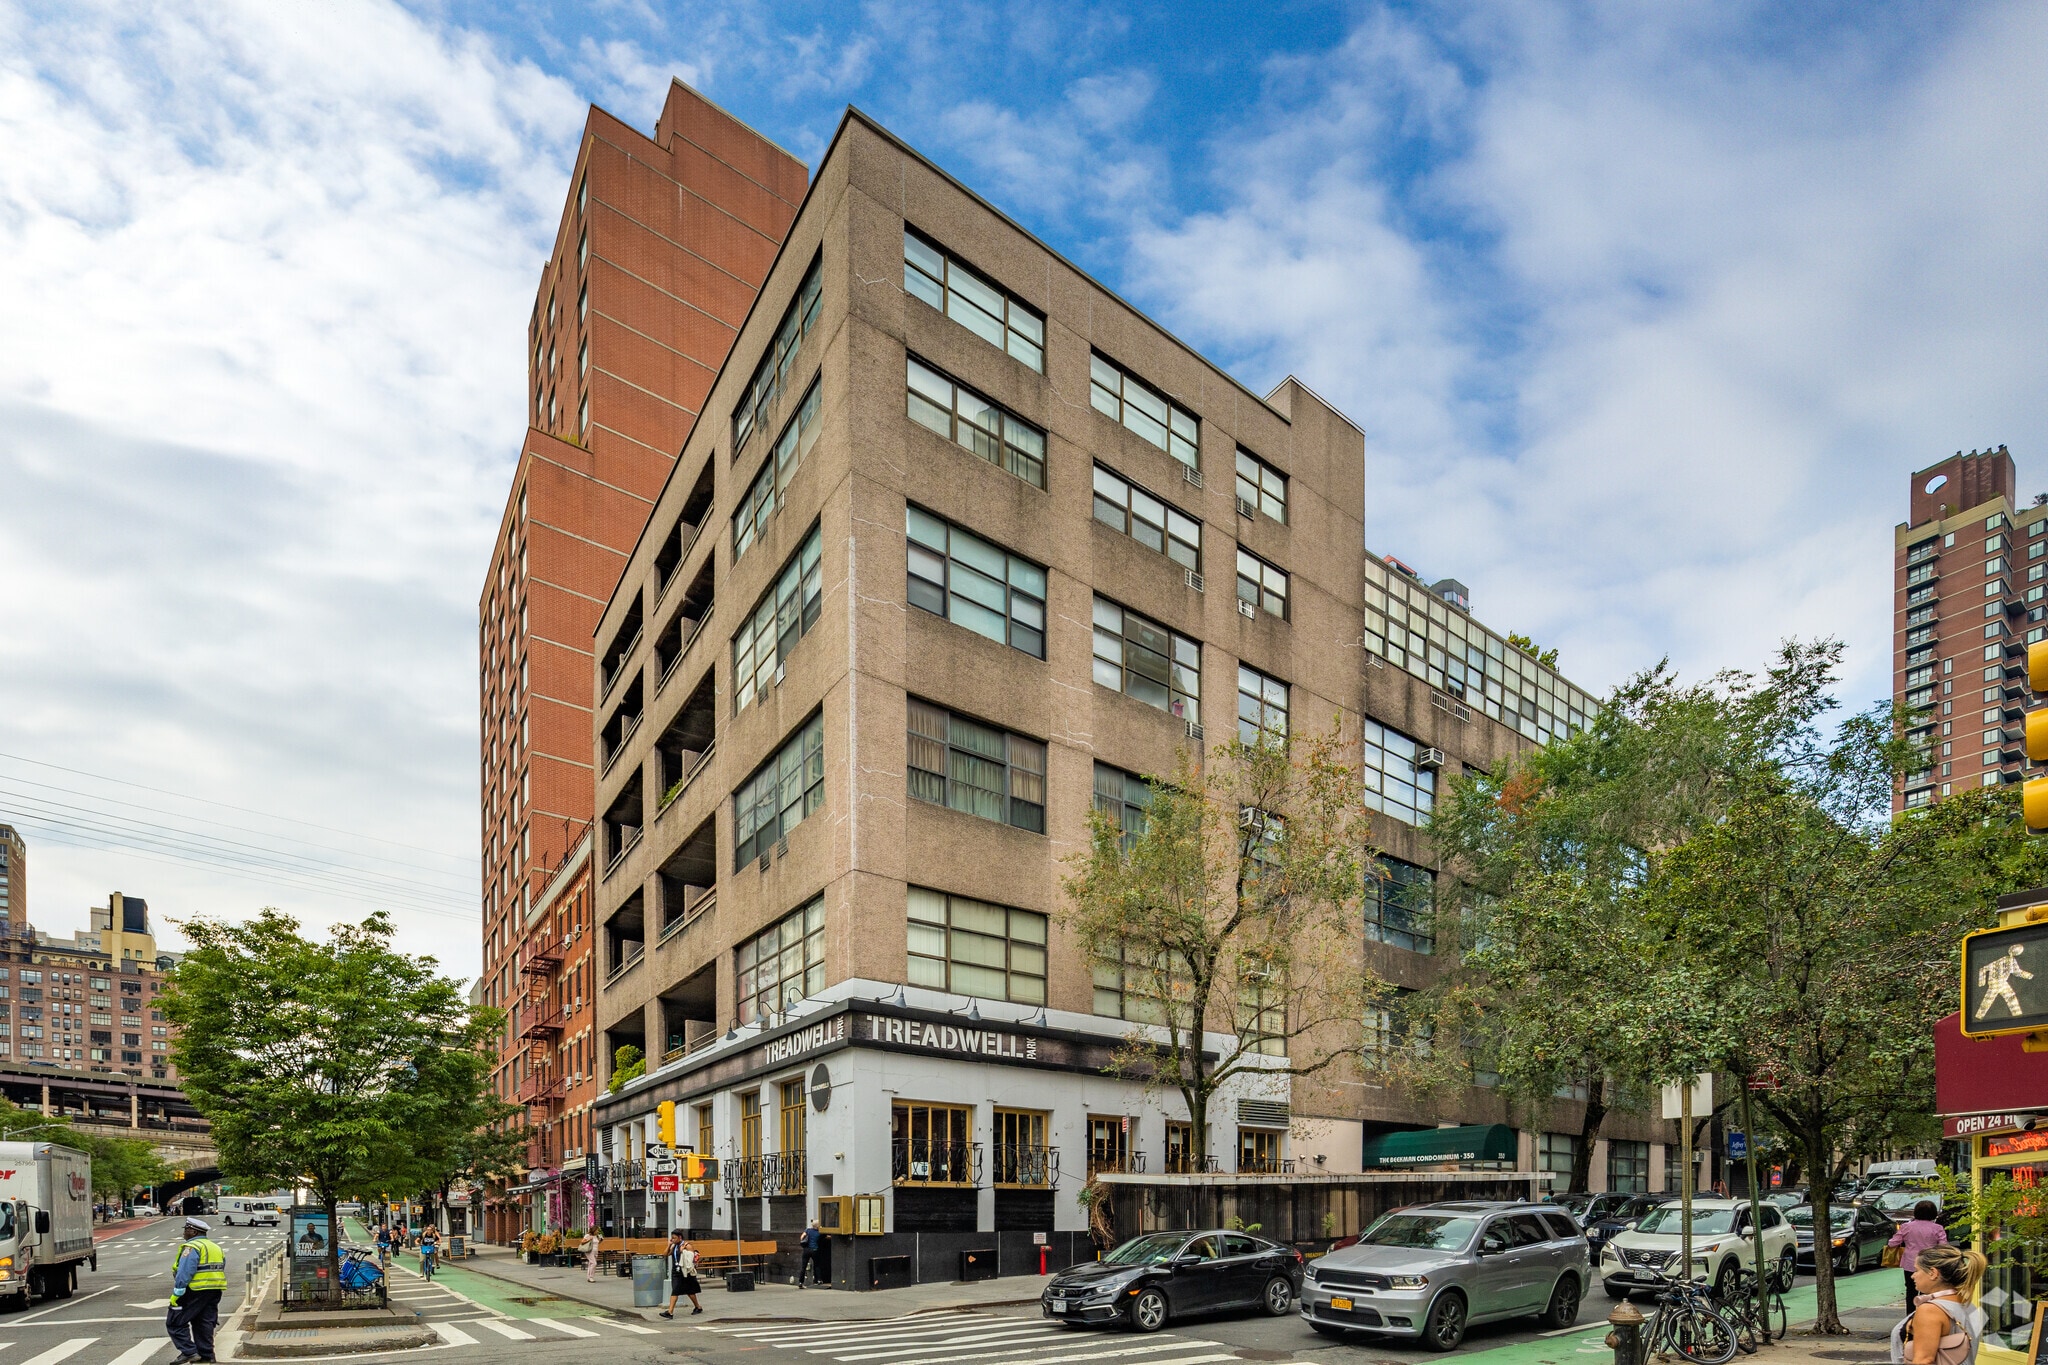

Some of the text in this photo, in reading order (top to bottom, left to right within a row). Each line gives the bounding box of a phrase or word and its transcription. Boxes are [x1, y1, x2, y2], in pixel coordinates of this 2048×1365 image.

[836, 1015, 844, 1041] PARK
[866, 1014, 1024, 1059] TREADWELL
[764, 1020, 836, 1065] TREADWELL
[1026, 1037, 1037, 1060] PARK
[1956, 1116, 1985, 1134] OPEN
[1987, 1115, 2001, 1128] 24
[1389, 1155, 1416, 1163] BEEKMAN
[1416, 1153, 1460, 1162] CONDOMINIUM
[296, 1242, 314, 1250] STAY
[296, 1249, 329, 1257] AMAZING
